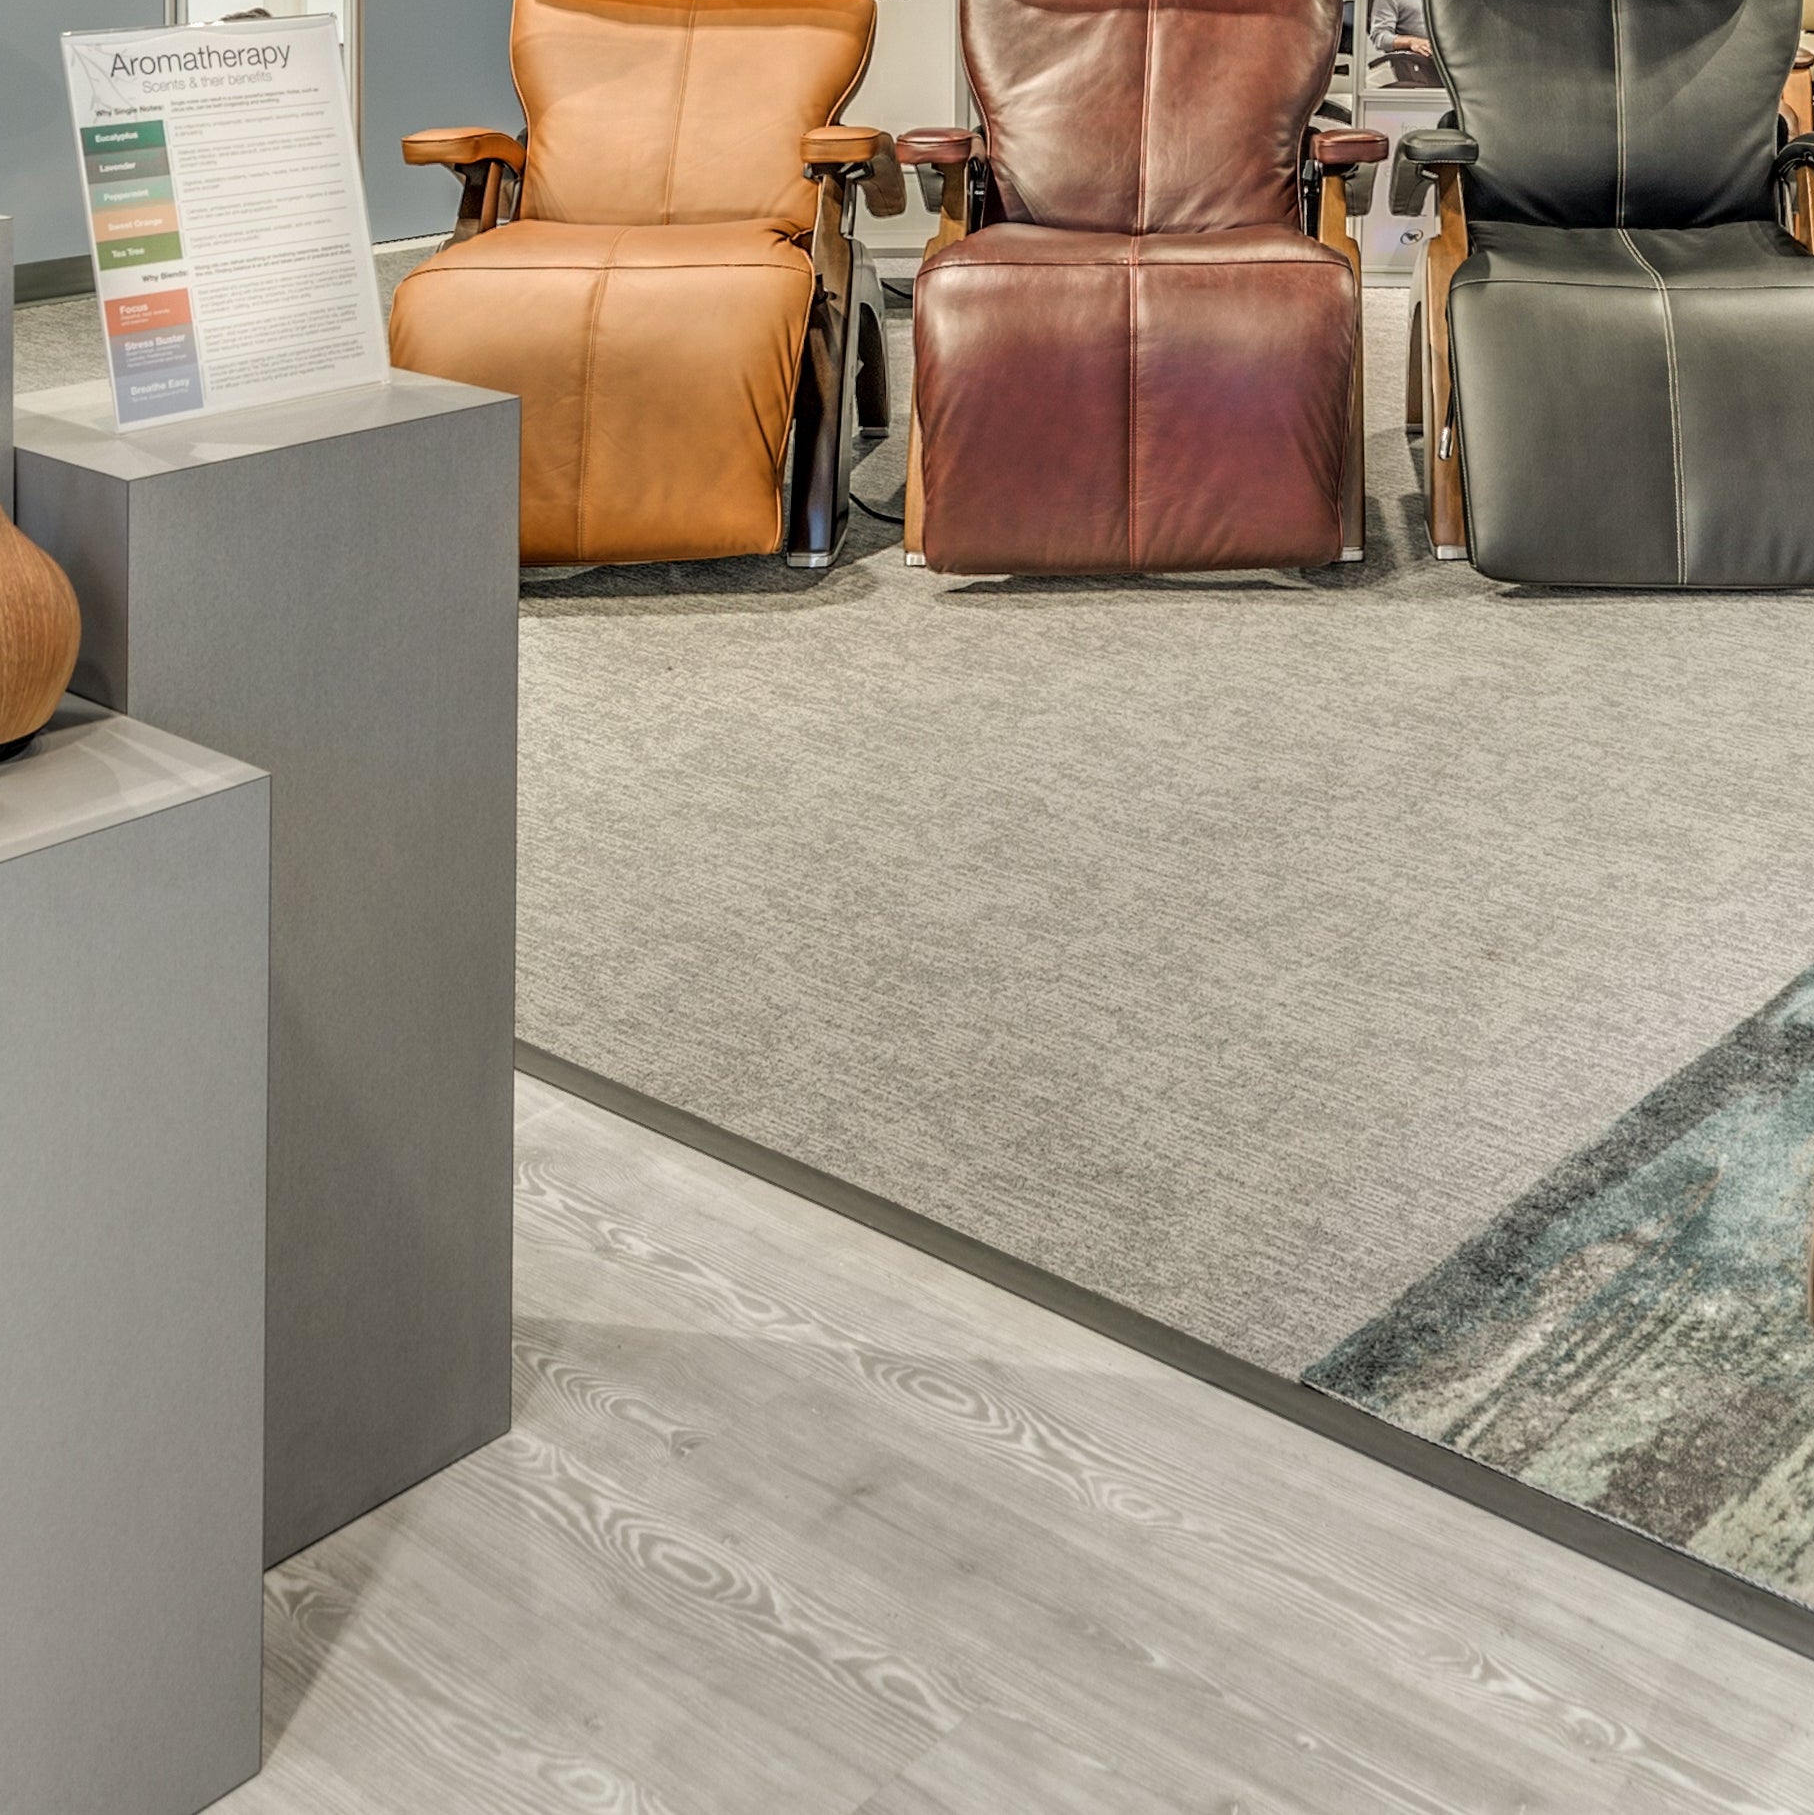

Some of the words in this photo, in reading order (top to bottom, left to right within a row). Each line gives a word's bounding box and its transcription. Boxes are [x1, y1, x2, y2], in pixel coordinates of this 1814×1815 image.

[110, 45, 291, 78] Aromatherapy
[141, 79, 186, 94] Scents
[189, 77, 198, 89] &
[201, 74, 225, 88] their
[228, 71, 273, 86] benefits
[119, 303, 149, 315] Focus
